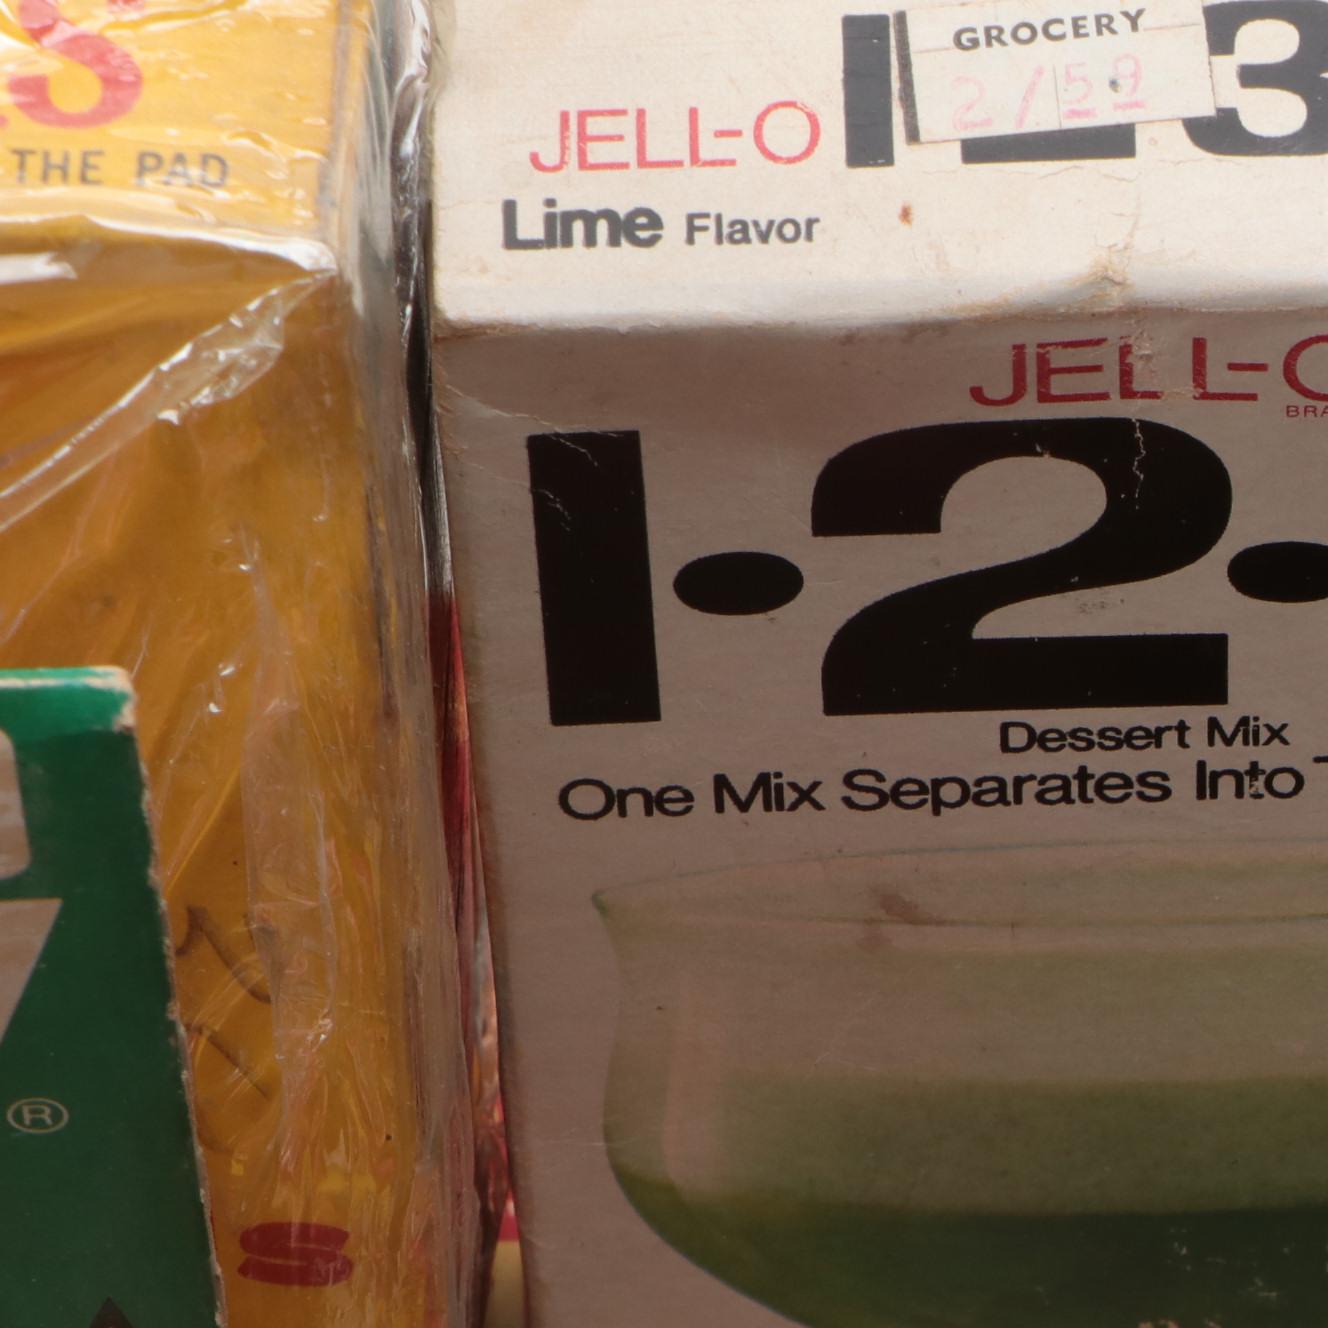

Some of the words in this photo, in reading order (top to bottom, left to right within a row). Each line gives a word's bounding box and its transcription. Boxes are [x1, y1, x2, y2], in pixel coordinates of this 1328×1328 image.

[952, 8, 1146, 52] GROCERY
[529, 100, 822, 174] JELL-O
[12, 148, 103, 187] THE
[135, 151, 231, 190] PAD
[501, 198, 664, 250] Lime
[685, 213, 820, 246] Flavor
[999, 716, 1191, 754] Dessert
[1207, 715, 1290, 748] Mix
[558, 778, 694, 821] One
[713, 771, 827, 814] Mix
[841, 764, 1173, 816] Separates
[1195, 760, 1306, 801] Into
